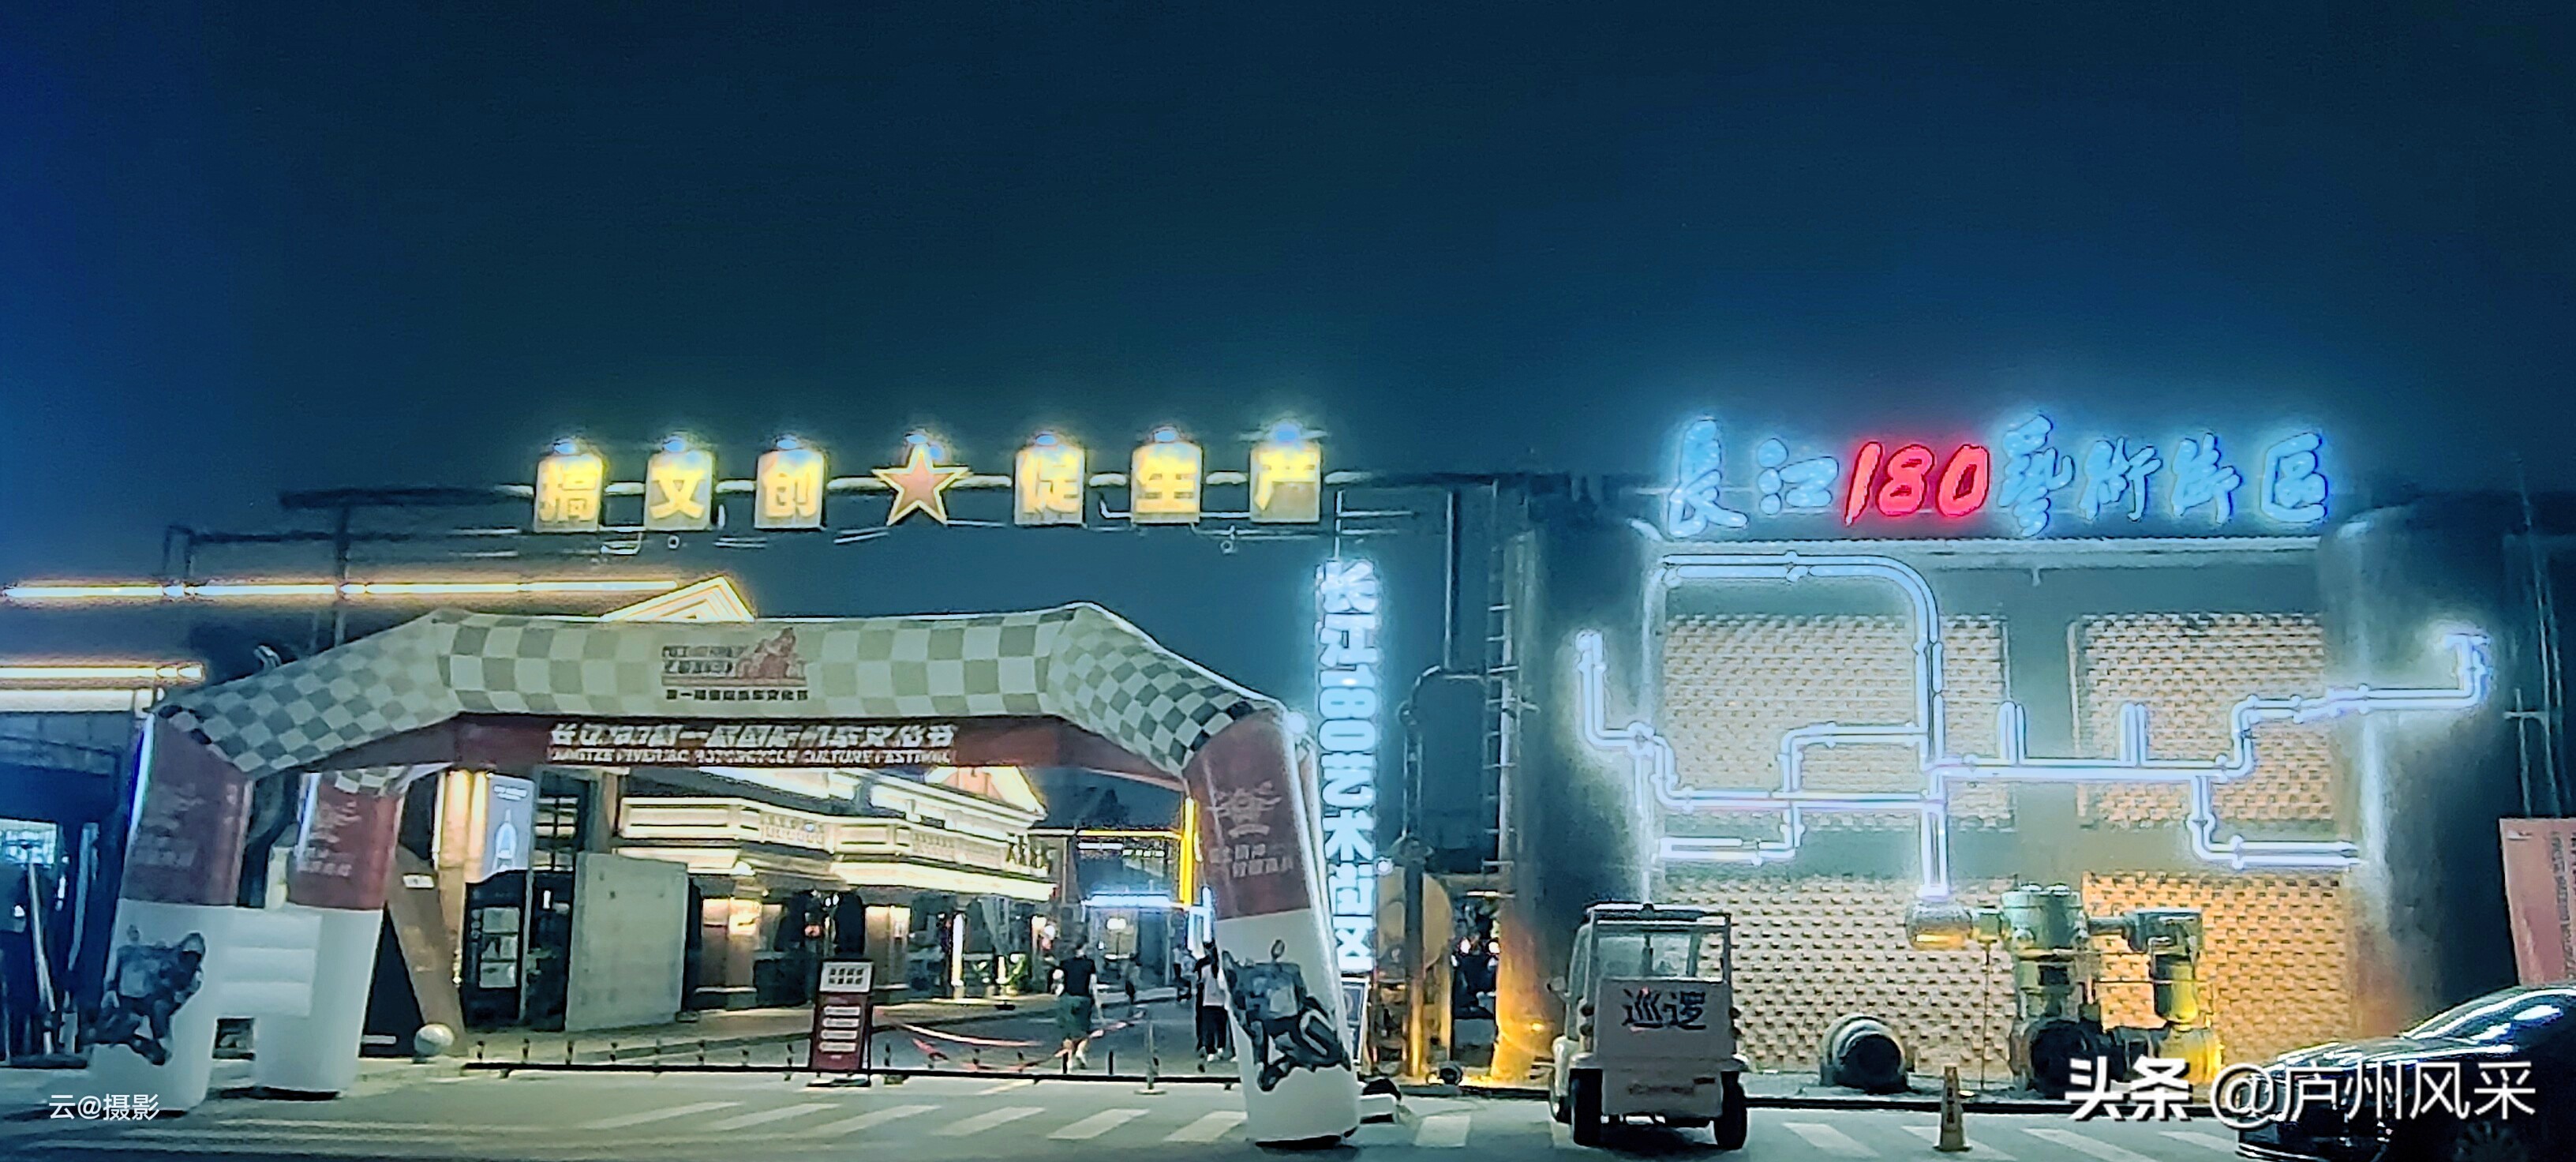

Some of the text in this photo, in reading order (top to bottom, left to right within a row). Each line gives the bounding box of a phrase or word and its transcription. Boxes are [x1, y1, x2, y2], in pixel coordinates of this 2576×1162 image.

[539, 447, 1314, 523] 搞文创 促生产
[1622, 988, 1706, 1030] 巡逻
